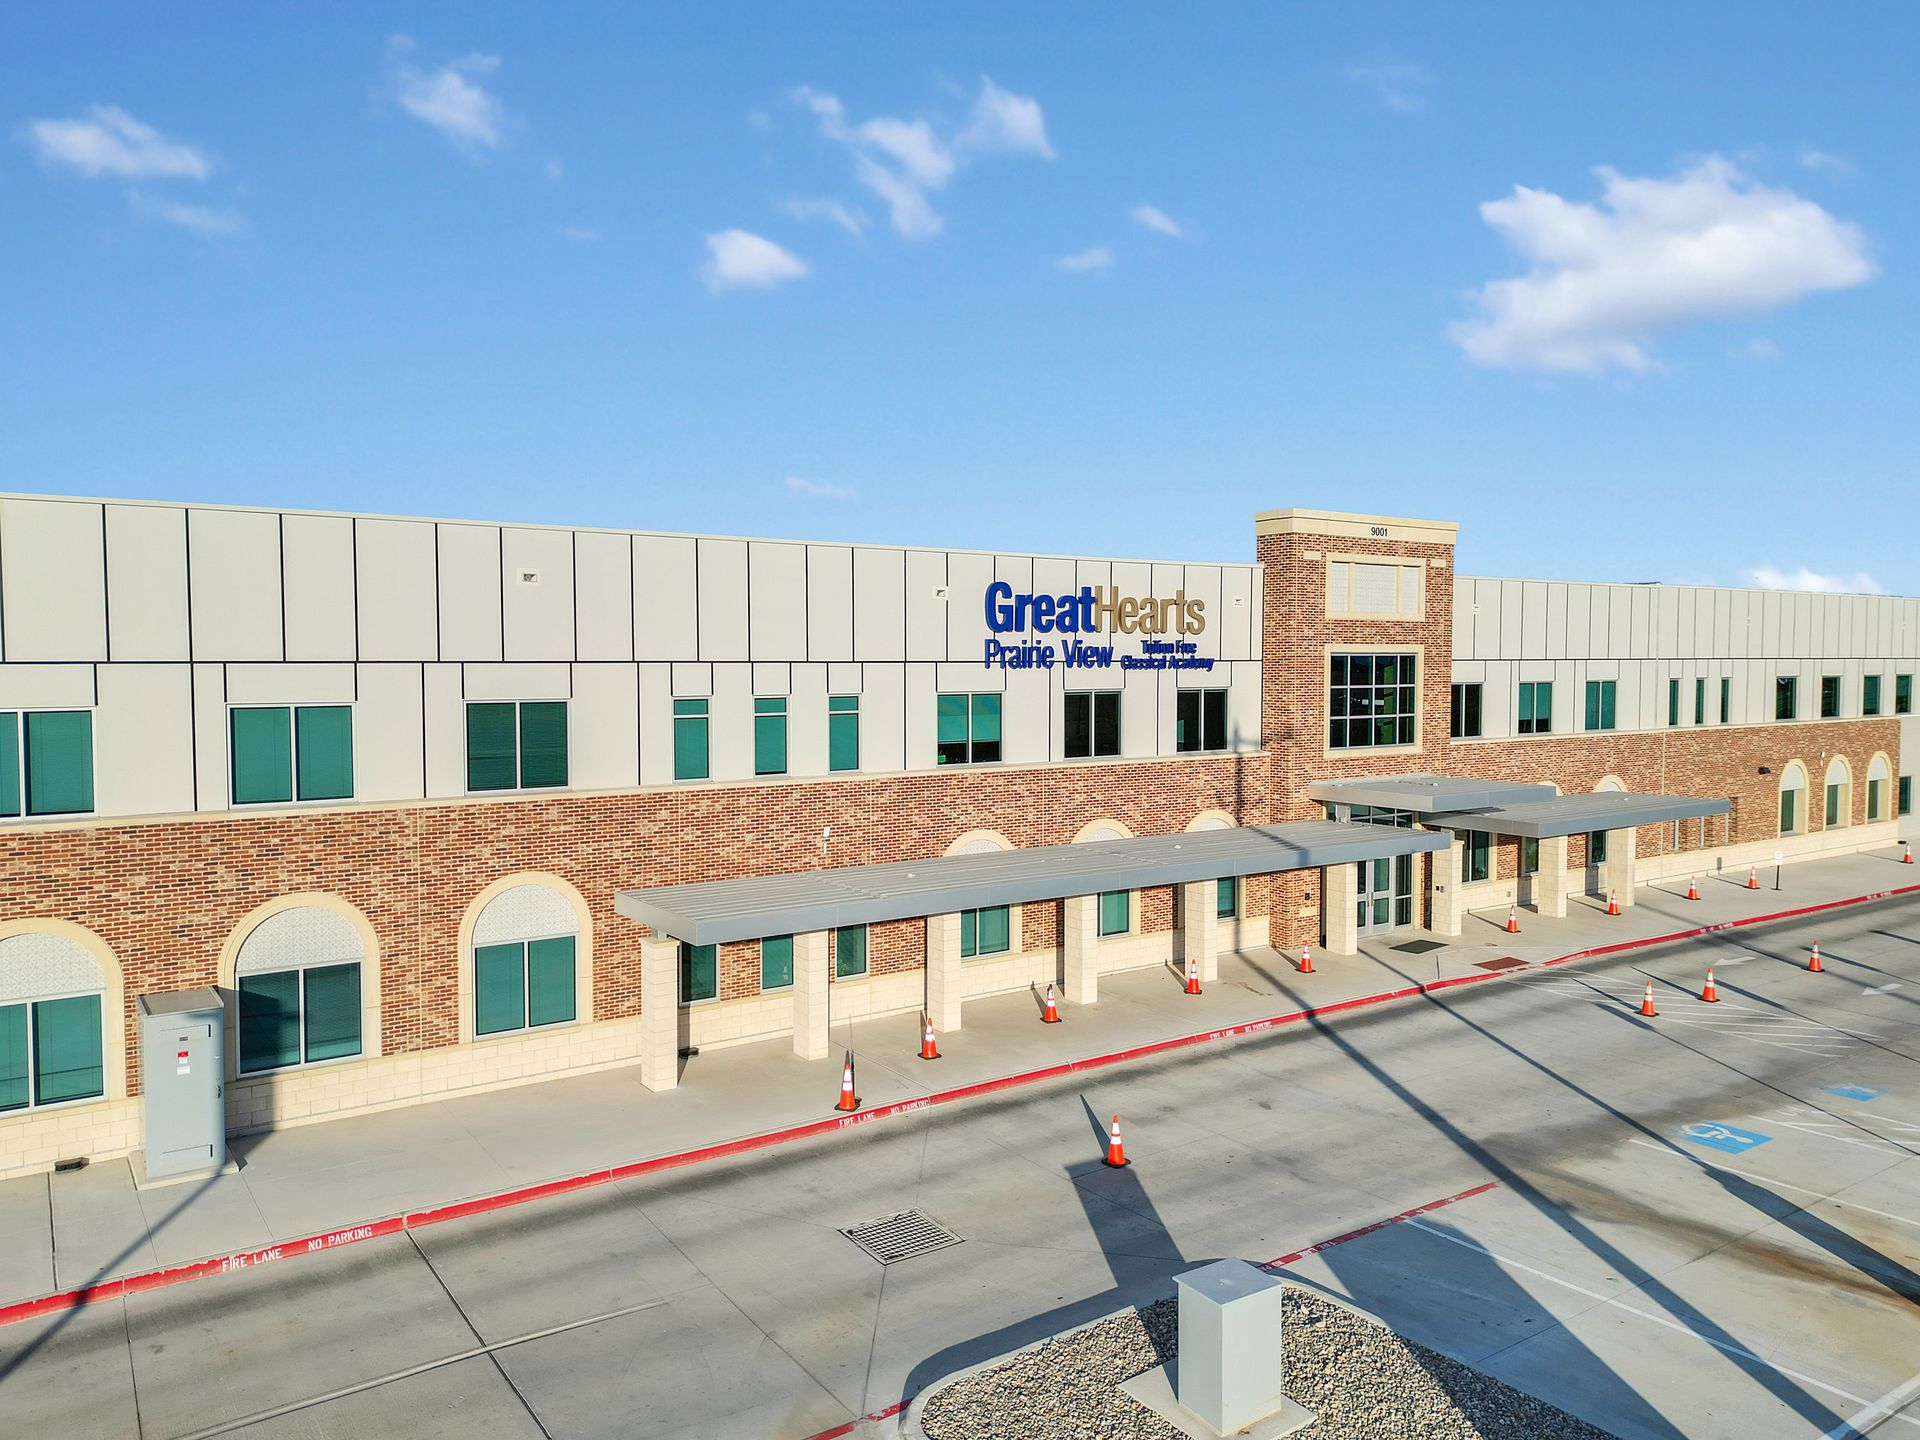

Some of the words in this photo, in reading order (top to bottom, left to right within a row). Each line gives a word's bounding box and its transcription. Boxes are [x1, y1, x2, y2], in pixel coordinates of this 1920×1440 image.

[1371, 527, 1388, 536] 9001
[985, 581, 1206, 635] GreatHearts
[984, 639, 1055, 670] Prairie
[1061, 639, 1114, 669] View
[1121, 655, 1167, 670] Classical
[1168, 655, 1215, 672] Academy
[839, 1117, 854, 1128] FIRE
[858, 1112, 875, 1123] LANE
[890, 1107, 899, 1115] NO
[903, 1100, 929, 1112] PARKING
[221, 1255, 248, 1273] FIRE
[253, 1247, 283, 1265] LANE
[307, 1238, 323, 1252] NO
[327, 1226, 372, 1247] PARKING
